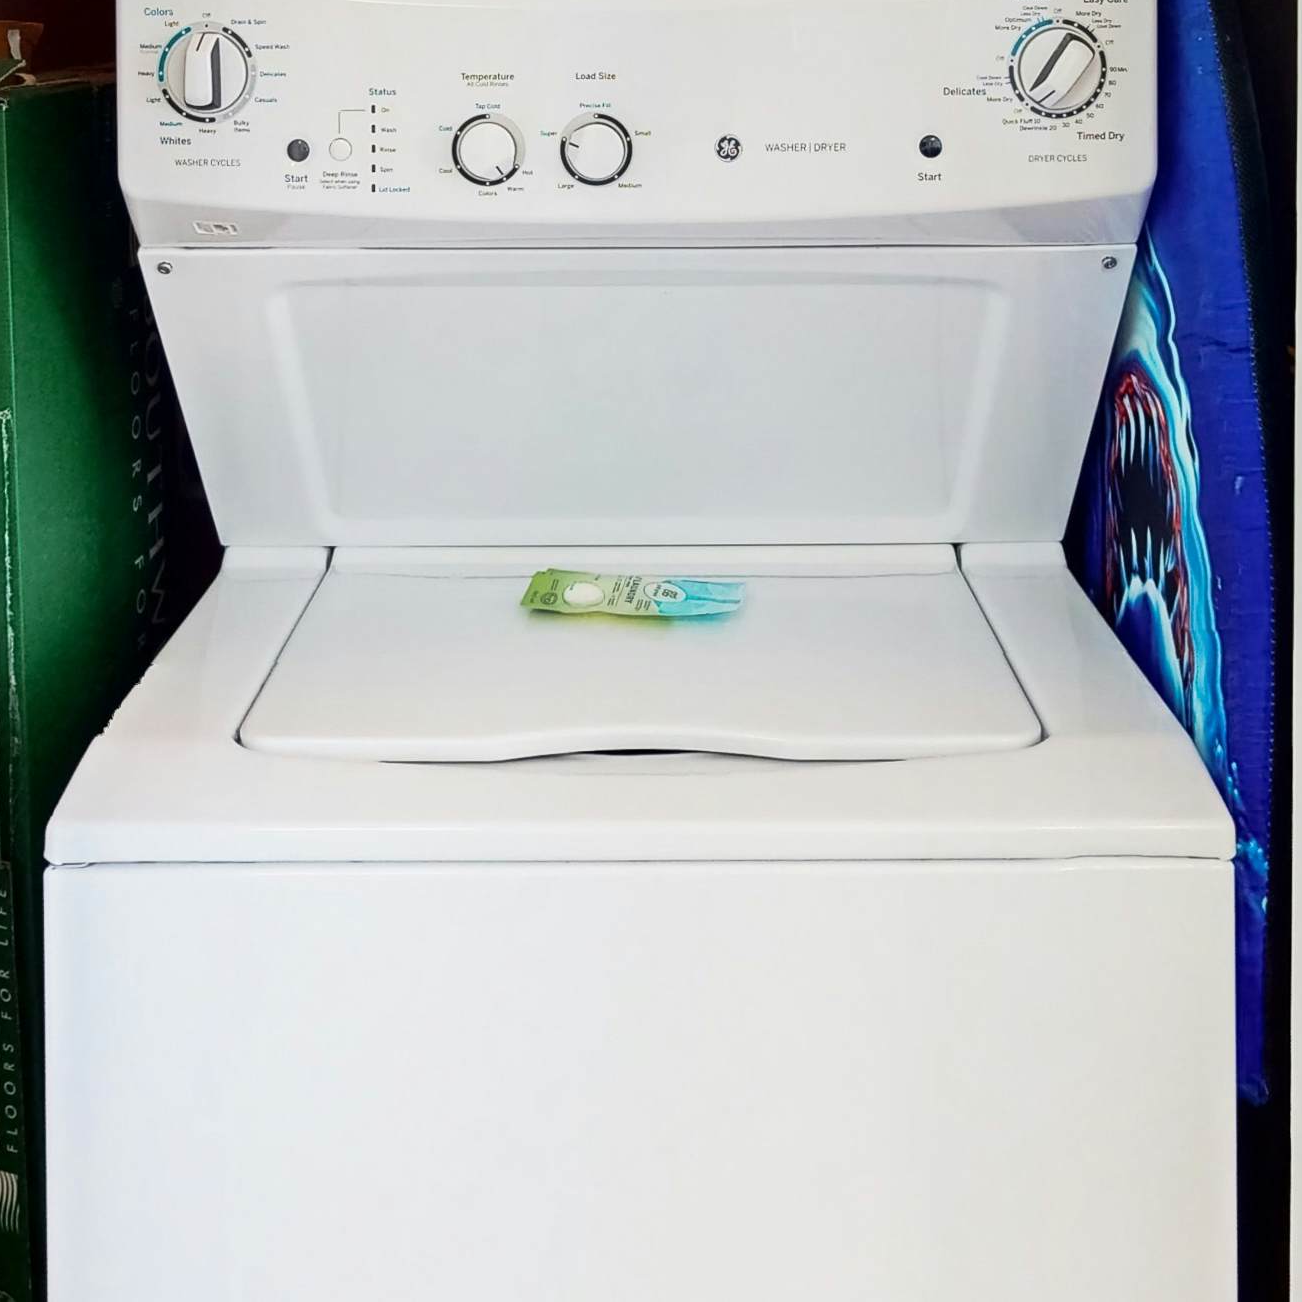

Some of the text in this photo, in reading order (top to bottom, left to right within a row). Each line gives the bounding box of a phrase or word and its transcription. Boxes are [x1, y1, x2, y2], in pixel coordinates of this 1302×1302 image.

[144, 8, 174, 16] Colors
[462, 73, 515, 82] Temperature
[369, 88, 397, 96] Status
[943, 88, 987, 96] Delicates
[160, 137, 191, 145] Whites
[1078, 132, 1125, 142] Timed Dry
[765, 143, 846, 152] WASHER DRYER
[175, 159, 241, 167] WASHER CYCLES
[285, 175, 308, 183] Start
[917, 173, 942, 181] Start
[128, 309, 145, 514] FLOORS
[2, 1042, 18, 1153] FLOORS
